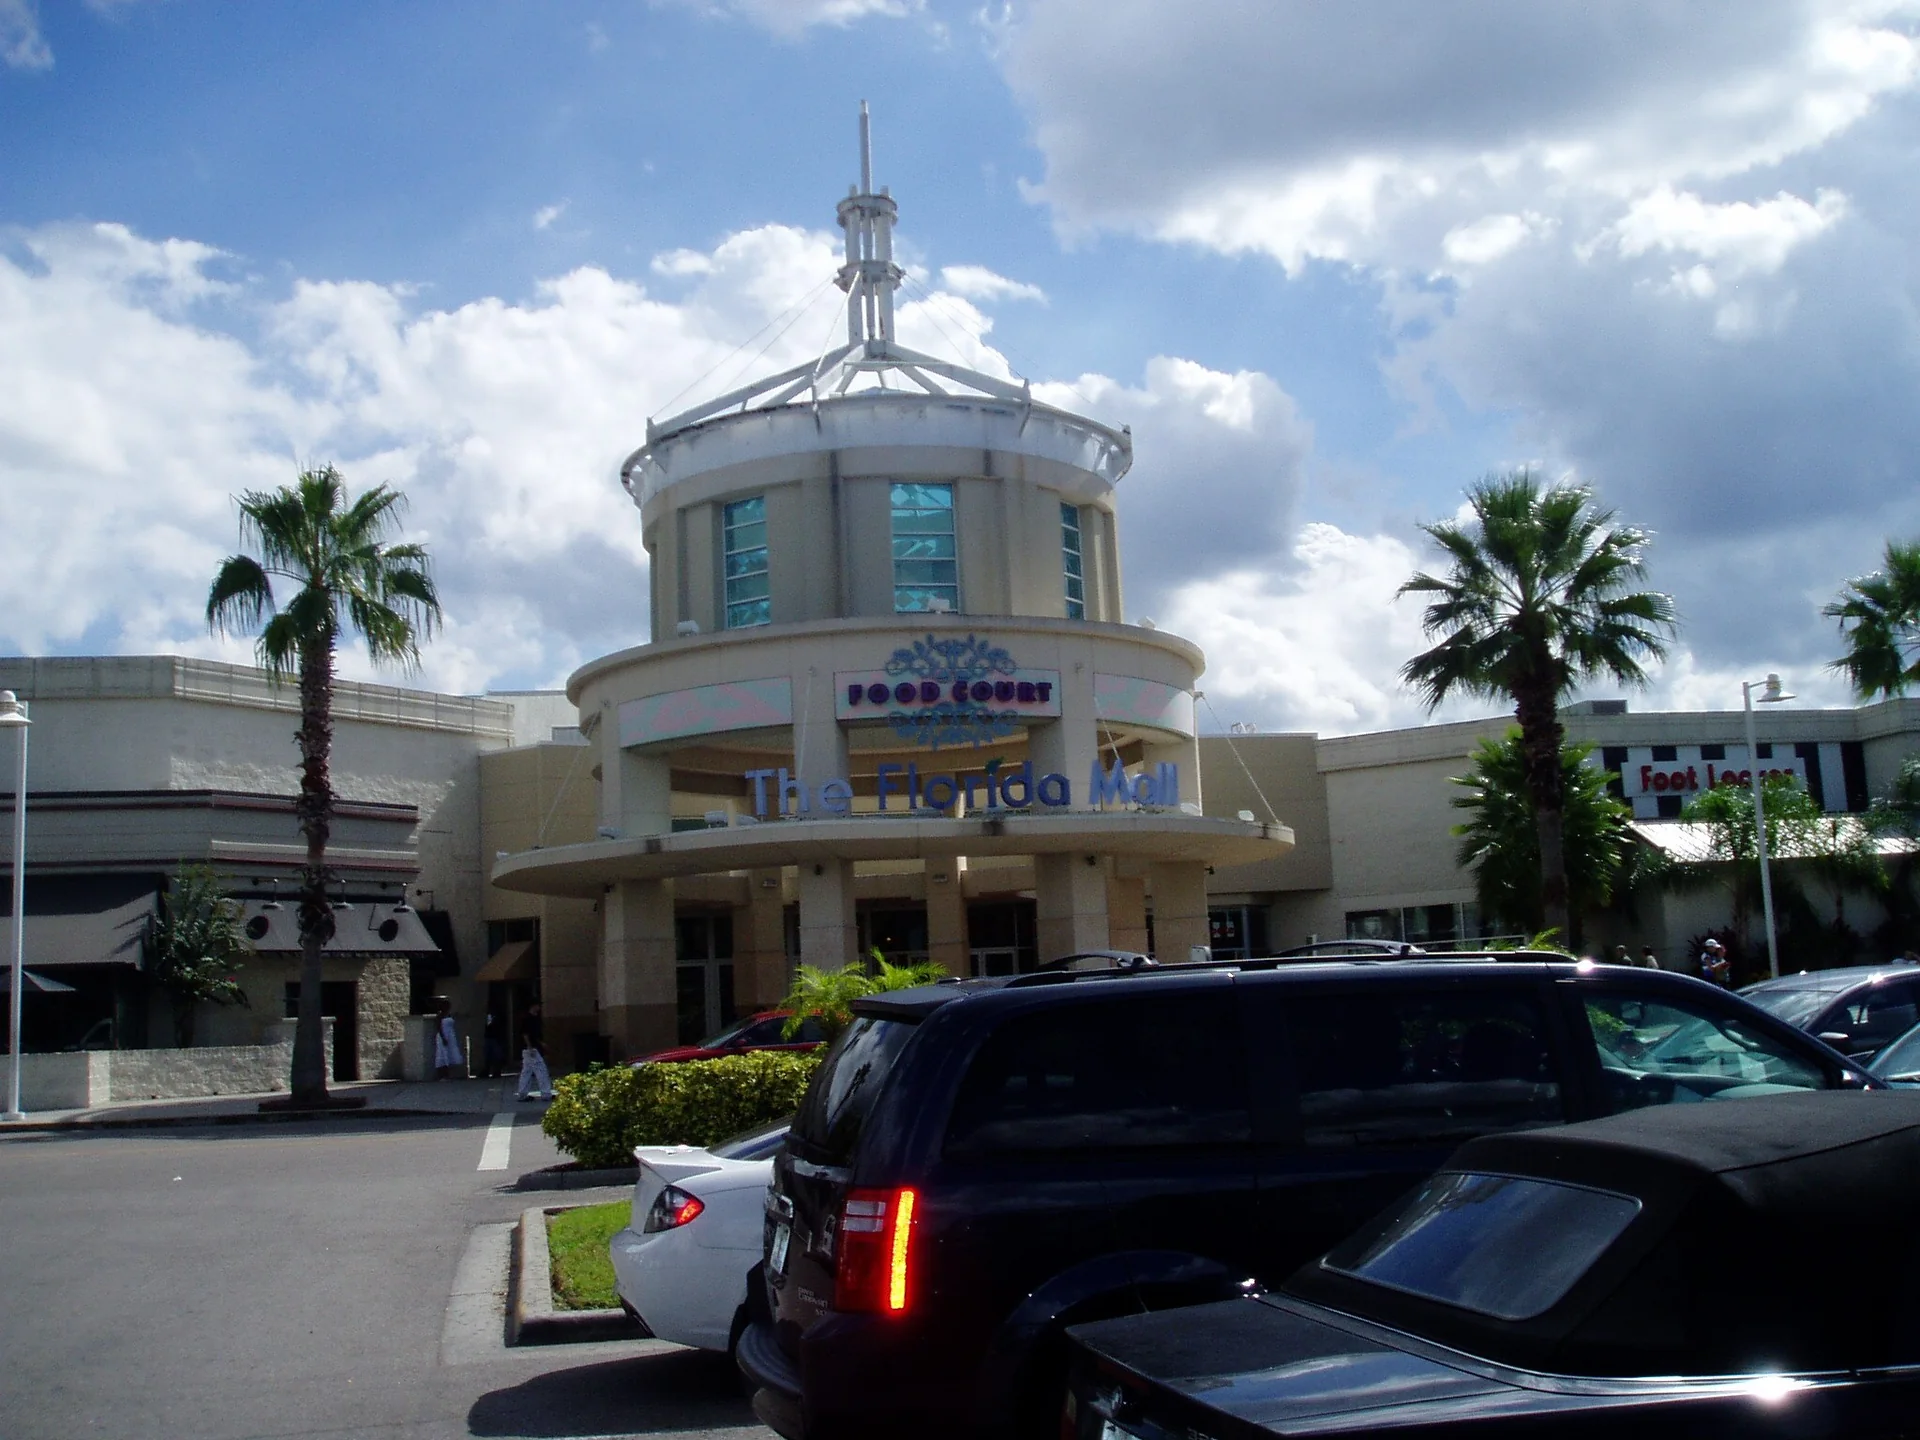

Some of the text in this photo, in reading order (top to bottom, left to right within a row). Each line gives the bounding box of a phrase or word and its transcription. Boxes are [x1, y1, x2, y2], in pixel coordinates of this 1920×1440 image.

[848, 680, 1053, 705] FOOD COURT
[744, 759, 1178, 816] The Florida Mall
[1639, 765, 1699, 793] Foot
